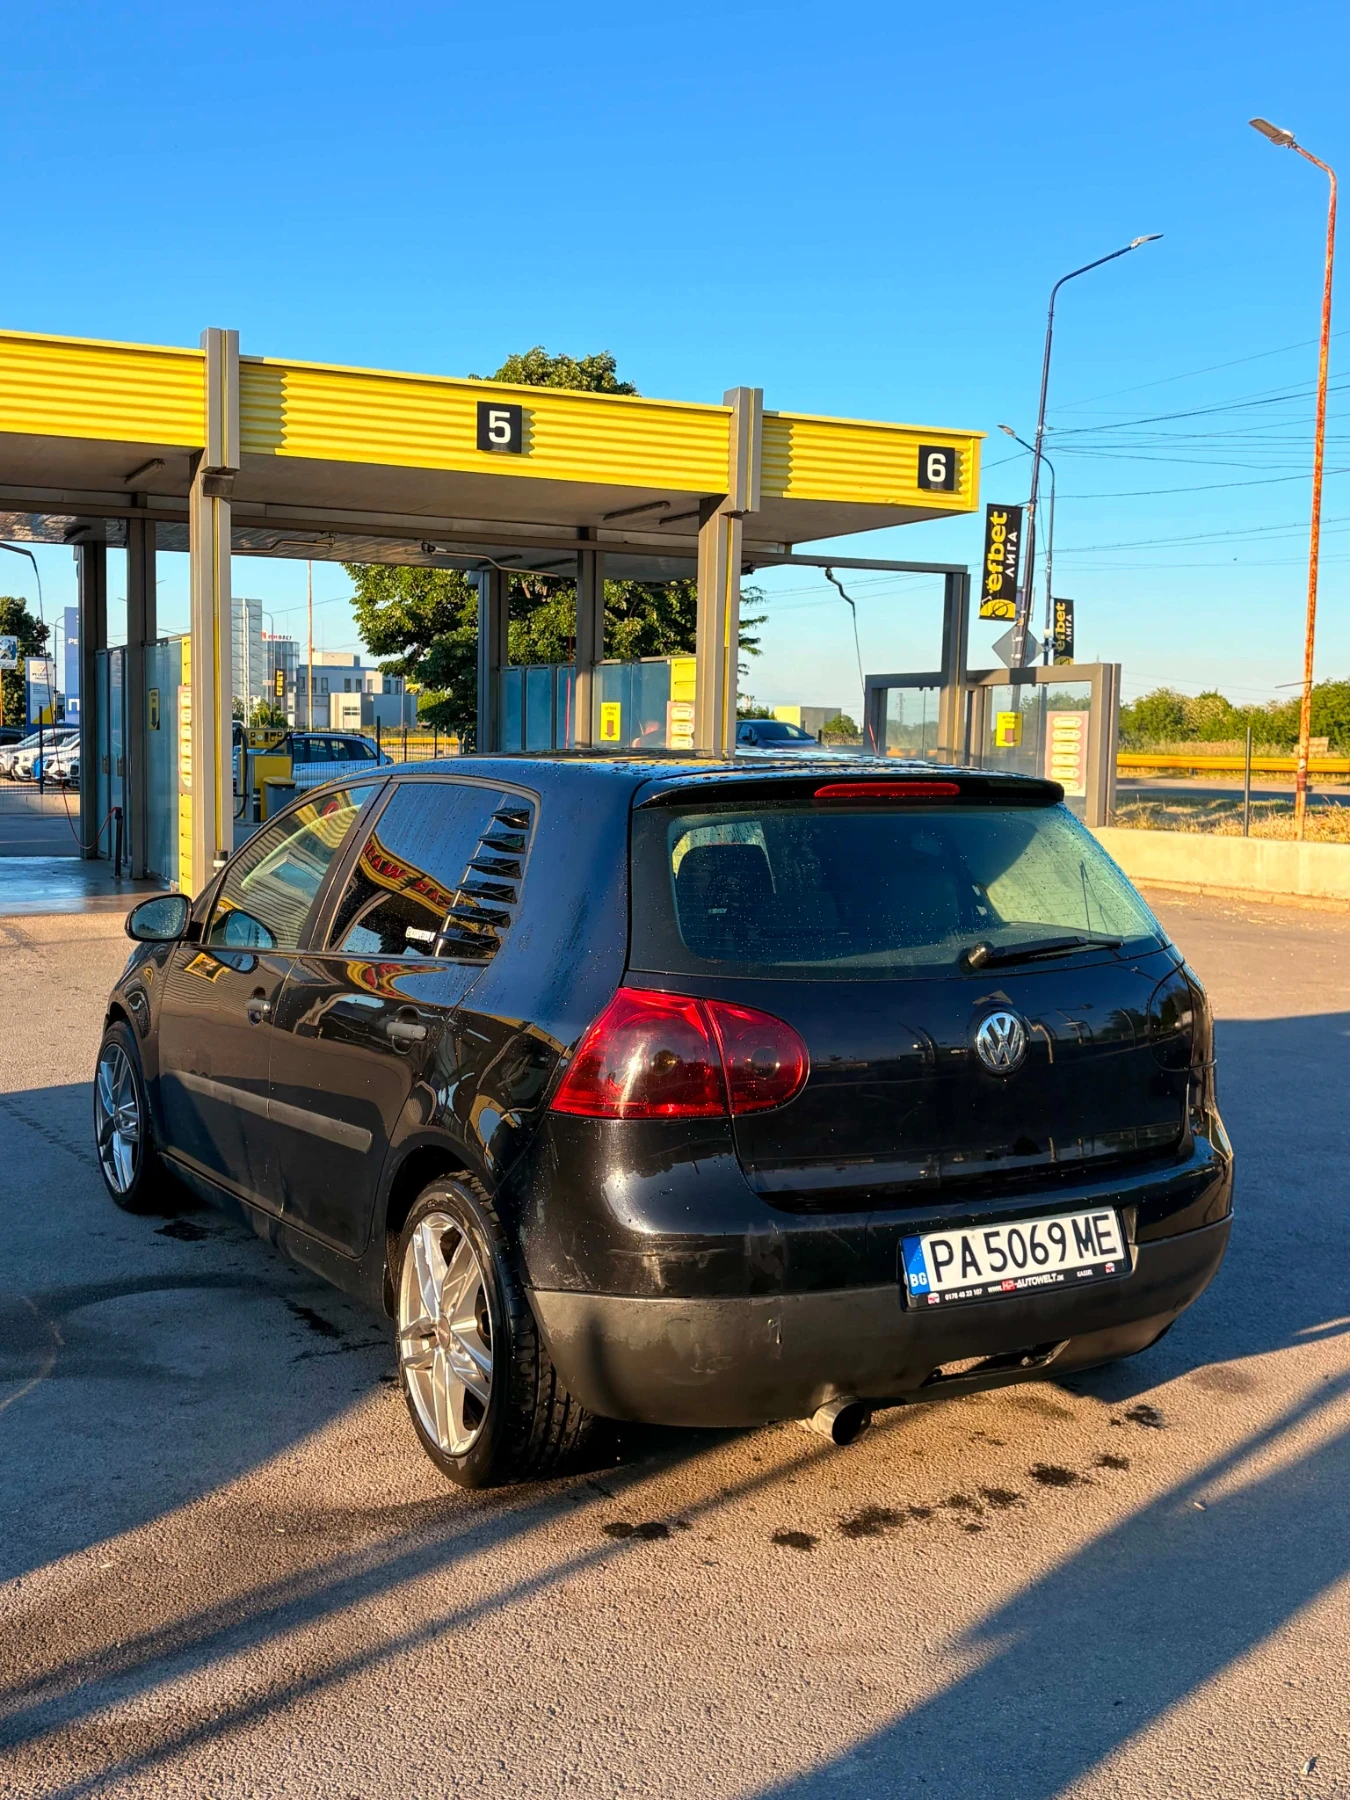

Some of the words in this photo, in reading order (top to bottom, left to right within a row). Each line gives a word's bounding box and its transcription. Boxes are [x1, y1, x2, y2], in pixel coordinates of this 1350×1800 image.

[489, 410, 511, 444] 5
[927, 453, 946, 483] 6
[985, 511, 1008, 593] efbet
[1005, 531, 1018, 578] ЛИГА
[1065, 614, 1073, 643] ЛИГА
[977, 1012, 1025, 1072] VW
[910, 1273, 928, 1287] BG
